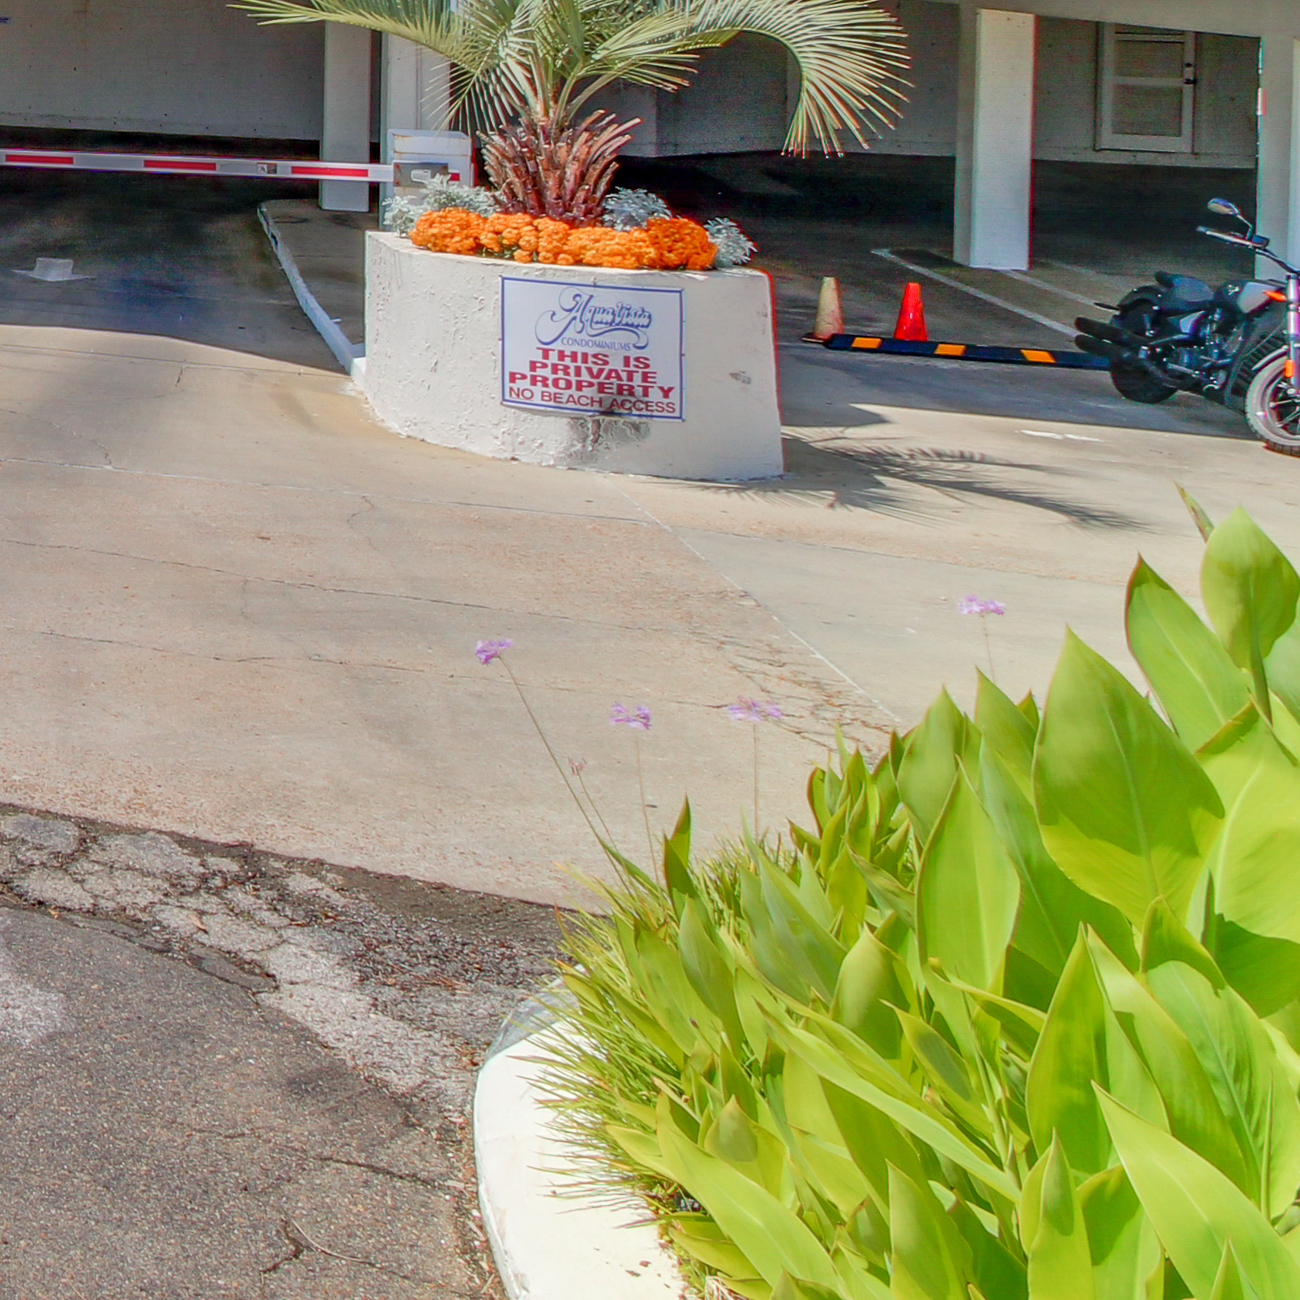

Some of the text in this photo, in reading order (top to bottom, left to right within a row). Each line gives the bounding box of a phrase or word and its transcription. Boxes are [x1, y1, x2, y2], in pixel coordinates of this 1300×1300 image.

[560, 336, 632, 352] CONDOMINIUMS
[536, 347, 651, 370] THIS IS
[508, 371, 675, 399] PROPERTY
[529, 360, 658, 385] PRIVATE
[509, 387, 676, 413] NO BEACH ACCESS
